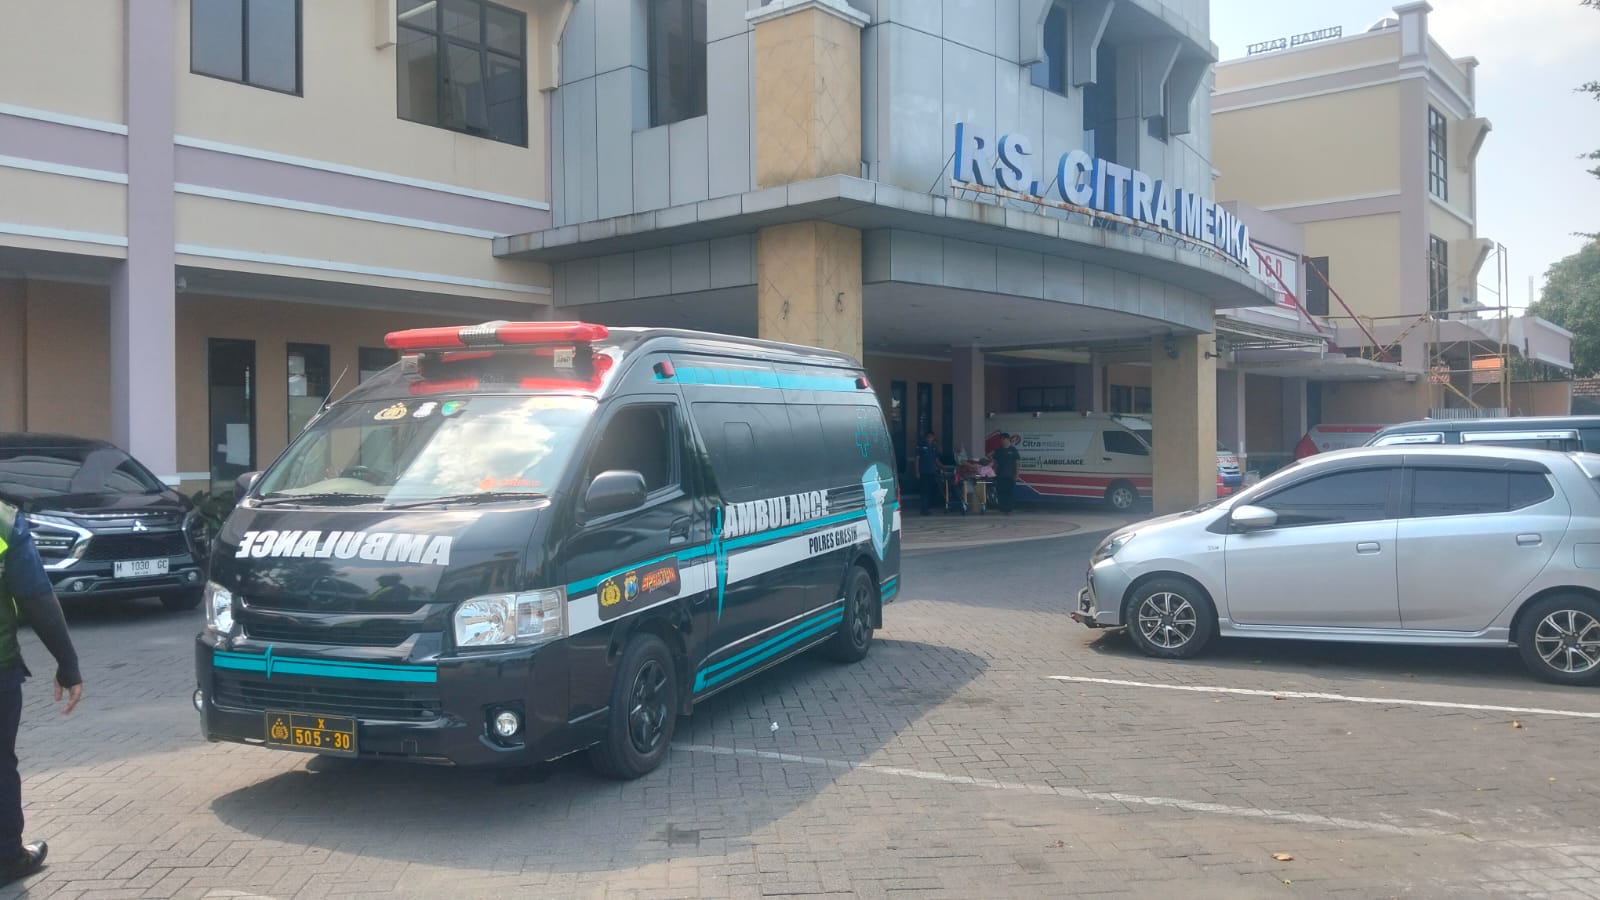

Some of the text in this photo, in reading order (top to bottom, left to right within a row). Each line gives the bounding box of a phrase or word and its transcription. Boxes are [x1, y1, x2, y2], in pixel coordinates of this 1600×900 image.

[954, 122, 1250, 267] RS. CITRA MEDIKA
[1043, 458, 1084, 466] AMBULANCE
[724, 489, 830, 539] AMBULANCE
[809, 531, 834, 555] POLRES
[131, 560, 149, 571] 1030
[157, 559, 168, 569] GC
[317, 718, 325, 729] X
